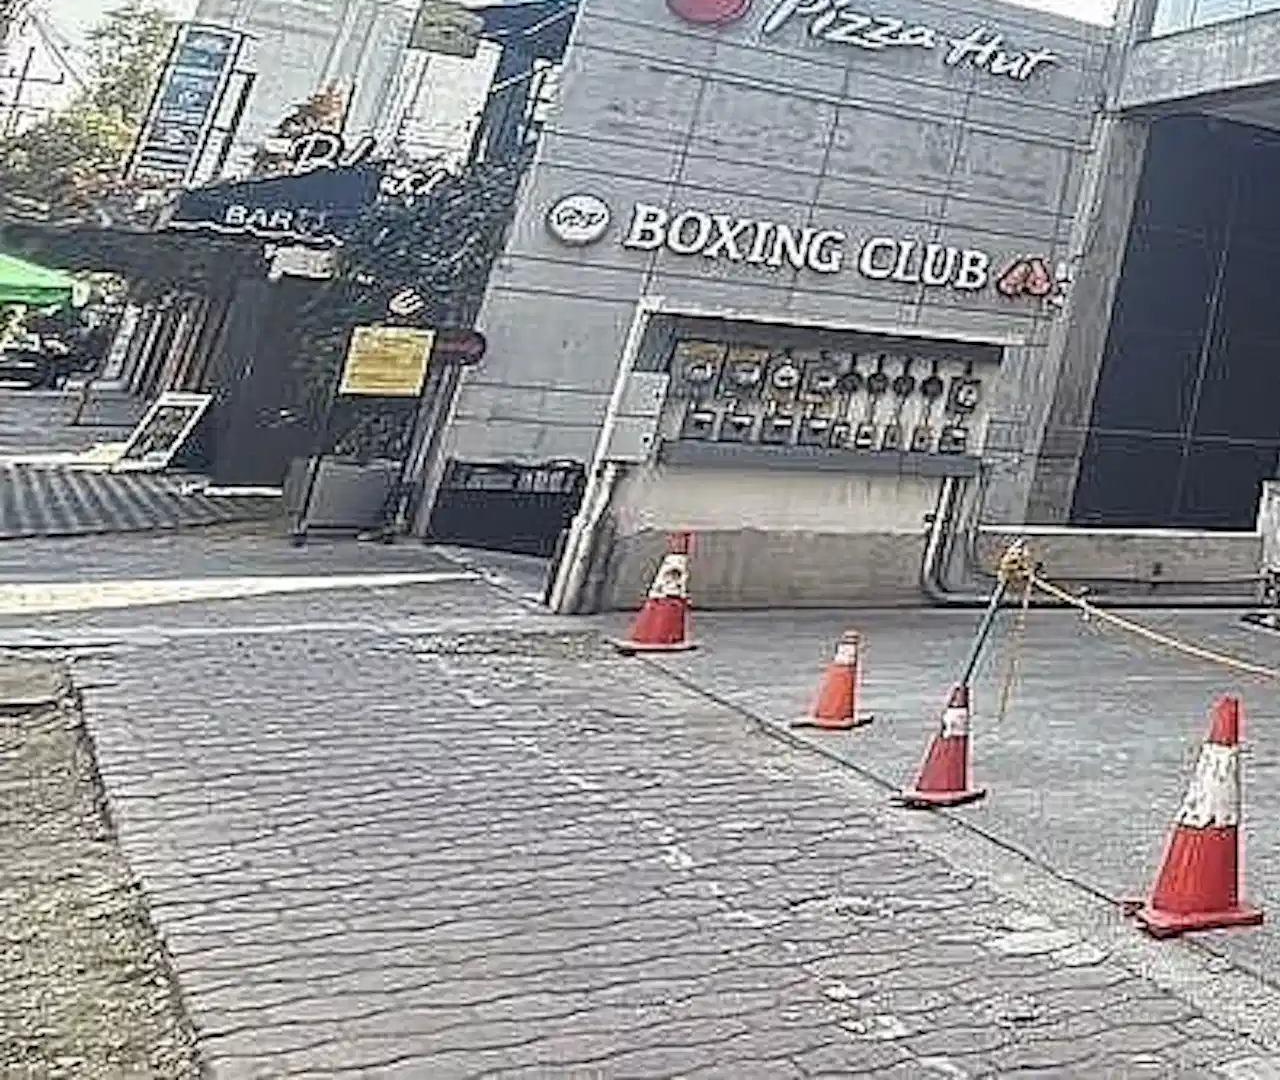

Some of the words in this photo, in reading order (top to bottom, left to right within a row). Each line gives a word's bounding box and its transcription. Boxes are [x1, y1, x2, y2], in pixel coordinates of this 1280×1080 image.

[945, 24, 1061, 82] Hut
[623, 202, 845, 273] BOXING
[857, 235, 990, 291] CLUB
